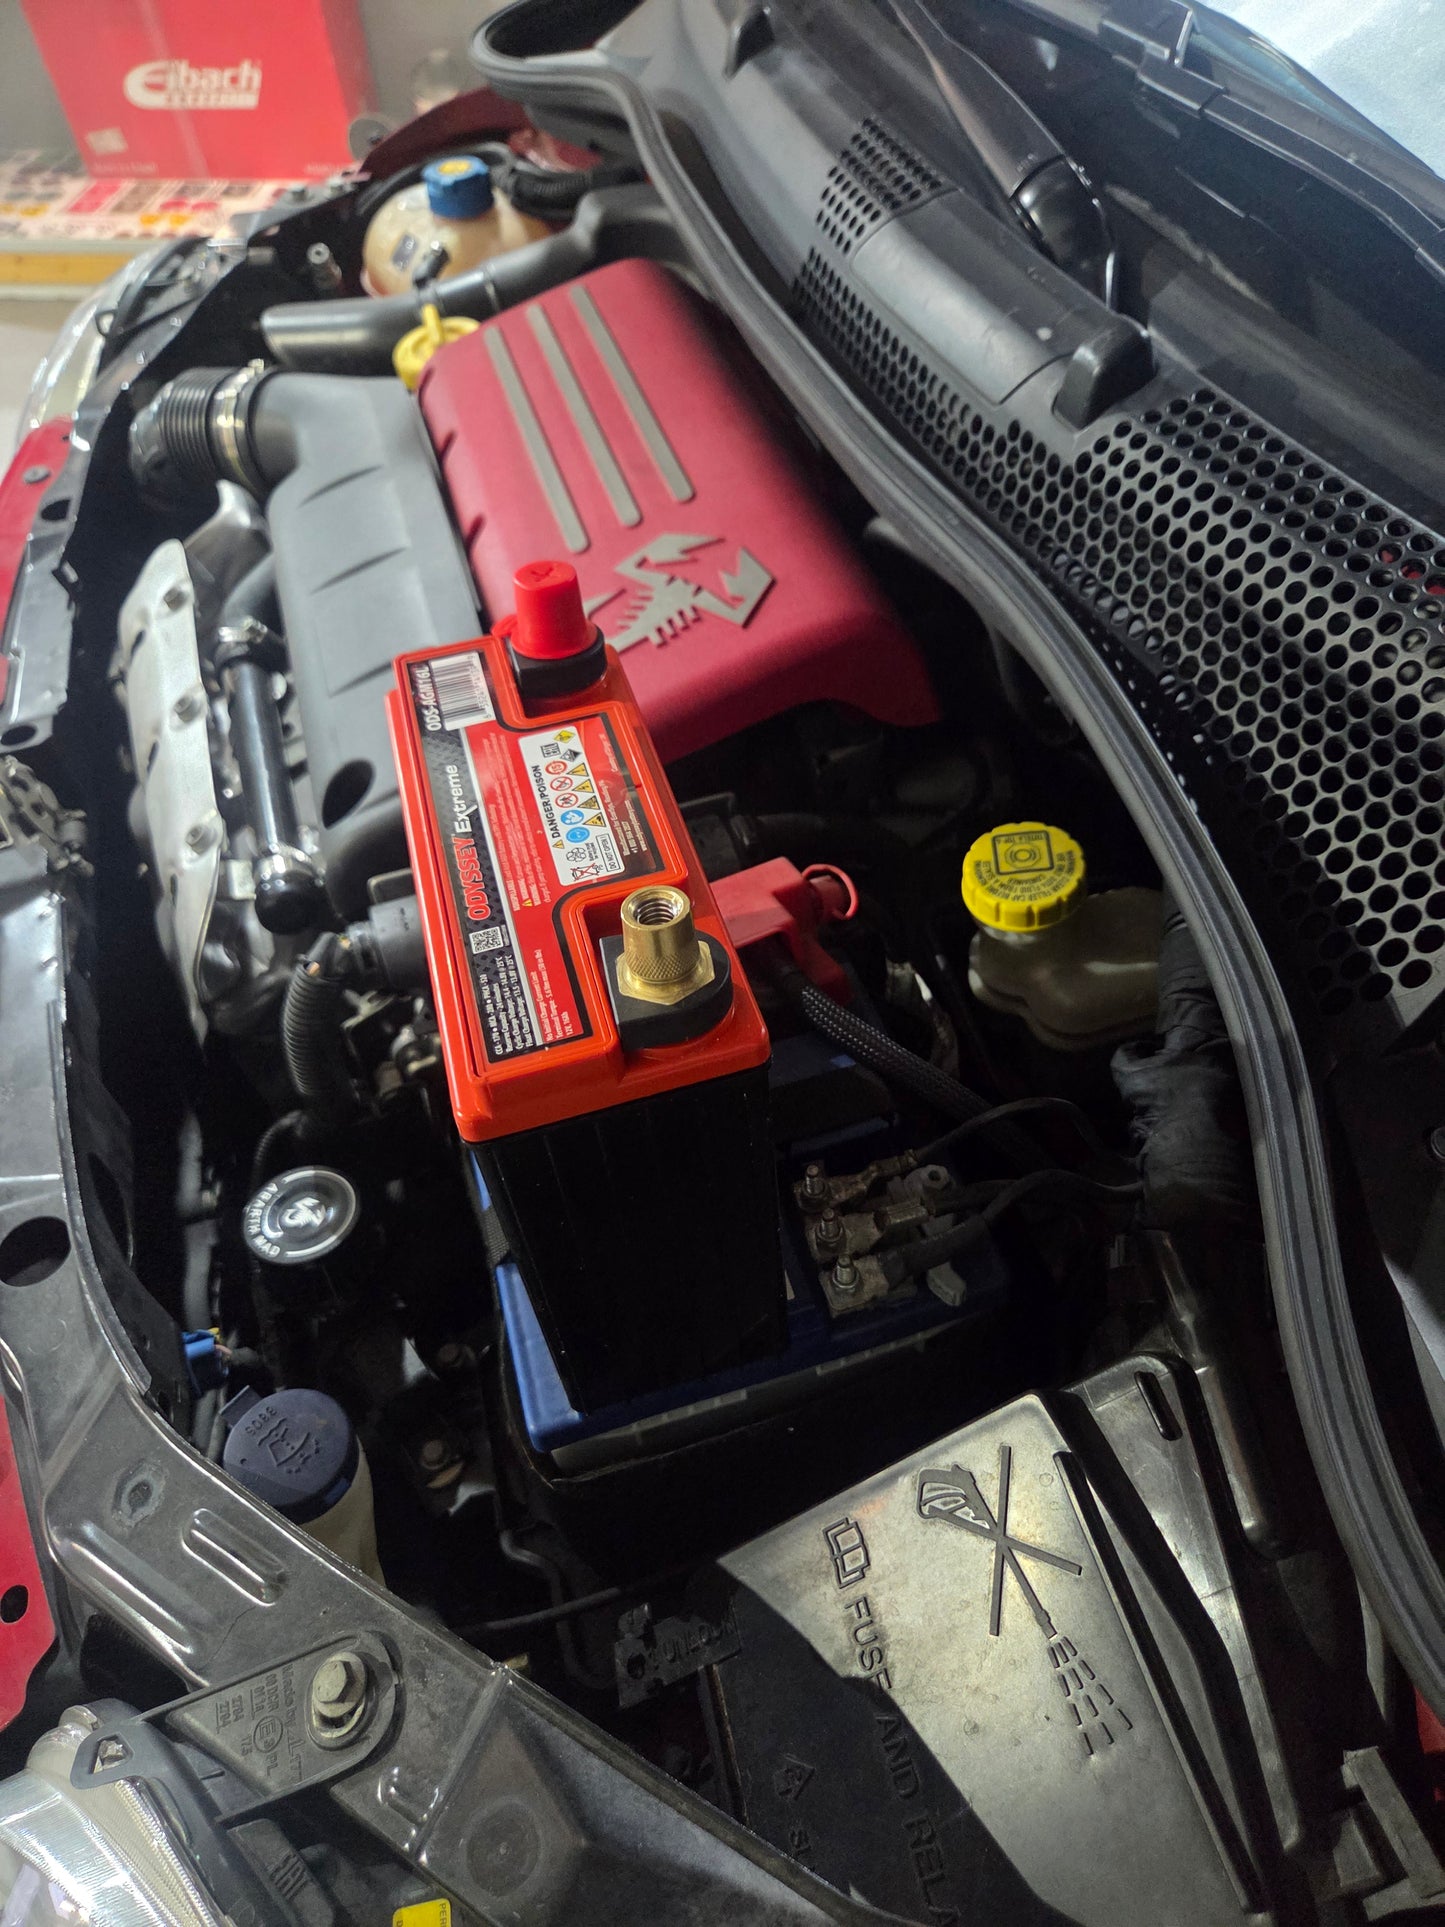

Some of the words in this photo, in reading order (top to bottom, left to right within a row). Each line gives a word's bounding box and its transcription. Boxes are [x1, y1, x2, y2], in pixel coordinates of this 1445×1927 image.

[124, 58, 261, 109] Eibach
[416, 666, 442, 731] ODS-AGM16L
[446, 763, 479, 833] Extreme
[531, 764, 561, 838] DANGER/POISON
[604, 850, 614, 861] NOT
[608, 861, 616, 869] DO
[452, 836, 492, 922] ODYSSEY
[528, 970, 540, 984] Limit
[481, 984, 491, 999] PHCA
[491, 982, 503, 1003] minutes
[502, 986, 512, 998] 14.4
[512, 984, 522, 996] 13.5
[531, 982, 544, 1002] Current
[495, 1001, 504, 1009] 24
[536, 1000, 549, 1018] Charge
[546, 999, 559, 1016] Torque
[497, 1010, 509, 1032] Capacity
[509, 1017, 520, 1035] Charge
[519, 1015, 531, 1034] Charge
[540, 1017, 552, 1034] Initial
[560, 1011, 571, 1024] 16Ah
[550, 1015, 564, 1038] Terminal
[491, 1031, 500, 1042] 170
[502, 1031, 514, 1052] Reserve
[513, 1034, 524, 1049] Cyclic
[523, 1032, 534, 1046] Float
[544, 1032, 554, 1041] No
[494, 1044, 503, 1055] CCA
[247, 1182, 279, 1235] ABARTH
[873, 1714, 921, 1800] AND
